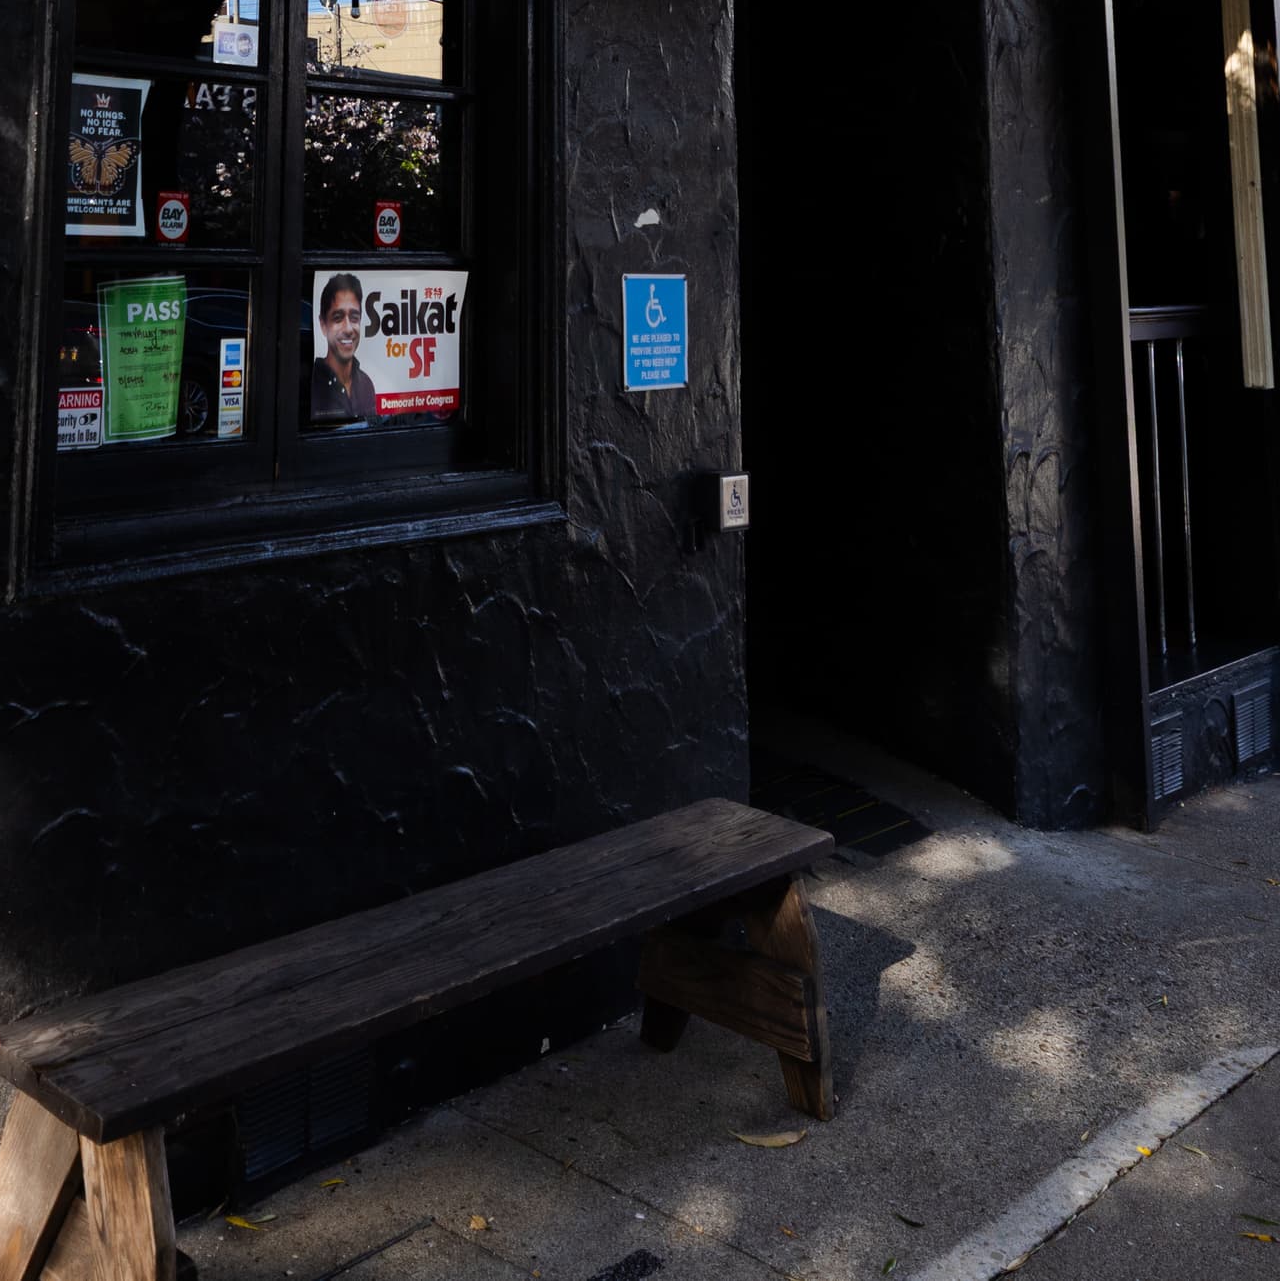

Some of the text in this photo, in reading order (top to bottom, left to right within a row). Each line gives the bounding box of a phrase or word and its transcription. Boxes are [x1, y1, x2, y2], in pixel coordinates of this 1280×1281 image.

[80, 109, 126, 120] NO KINGS.
[86, 118, 119, 128] NO ICE.
[82, 127, 123, 136] NO FEAR.
[67, 198, 131, 207] MMIGRANTS ARE
[67, 206, 105, 214] WELCOME
[161, 208, 184, 220] BAY
[160, 221, 183, 229] ALARM
[379, 215, 397, 227] BAY
[127, 300, 181, 323] PASS
[364, 289, 458, 338] Saikat
[386, 337, 437, 379] for SF
[58, 392, 100, 407] ARNING
[224, 398, 240, 407] VISA
[381, 394, 454, 409] Democrat for Congress
[77, 429, 84, 442] In
[85, 429, 97, 442] Use
